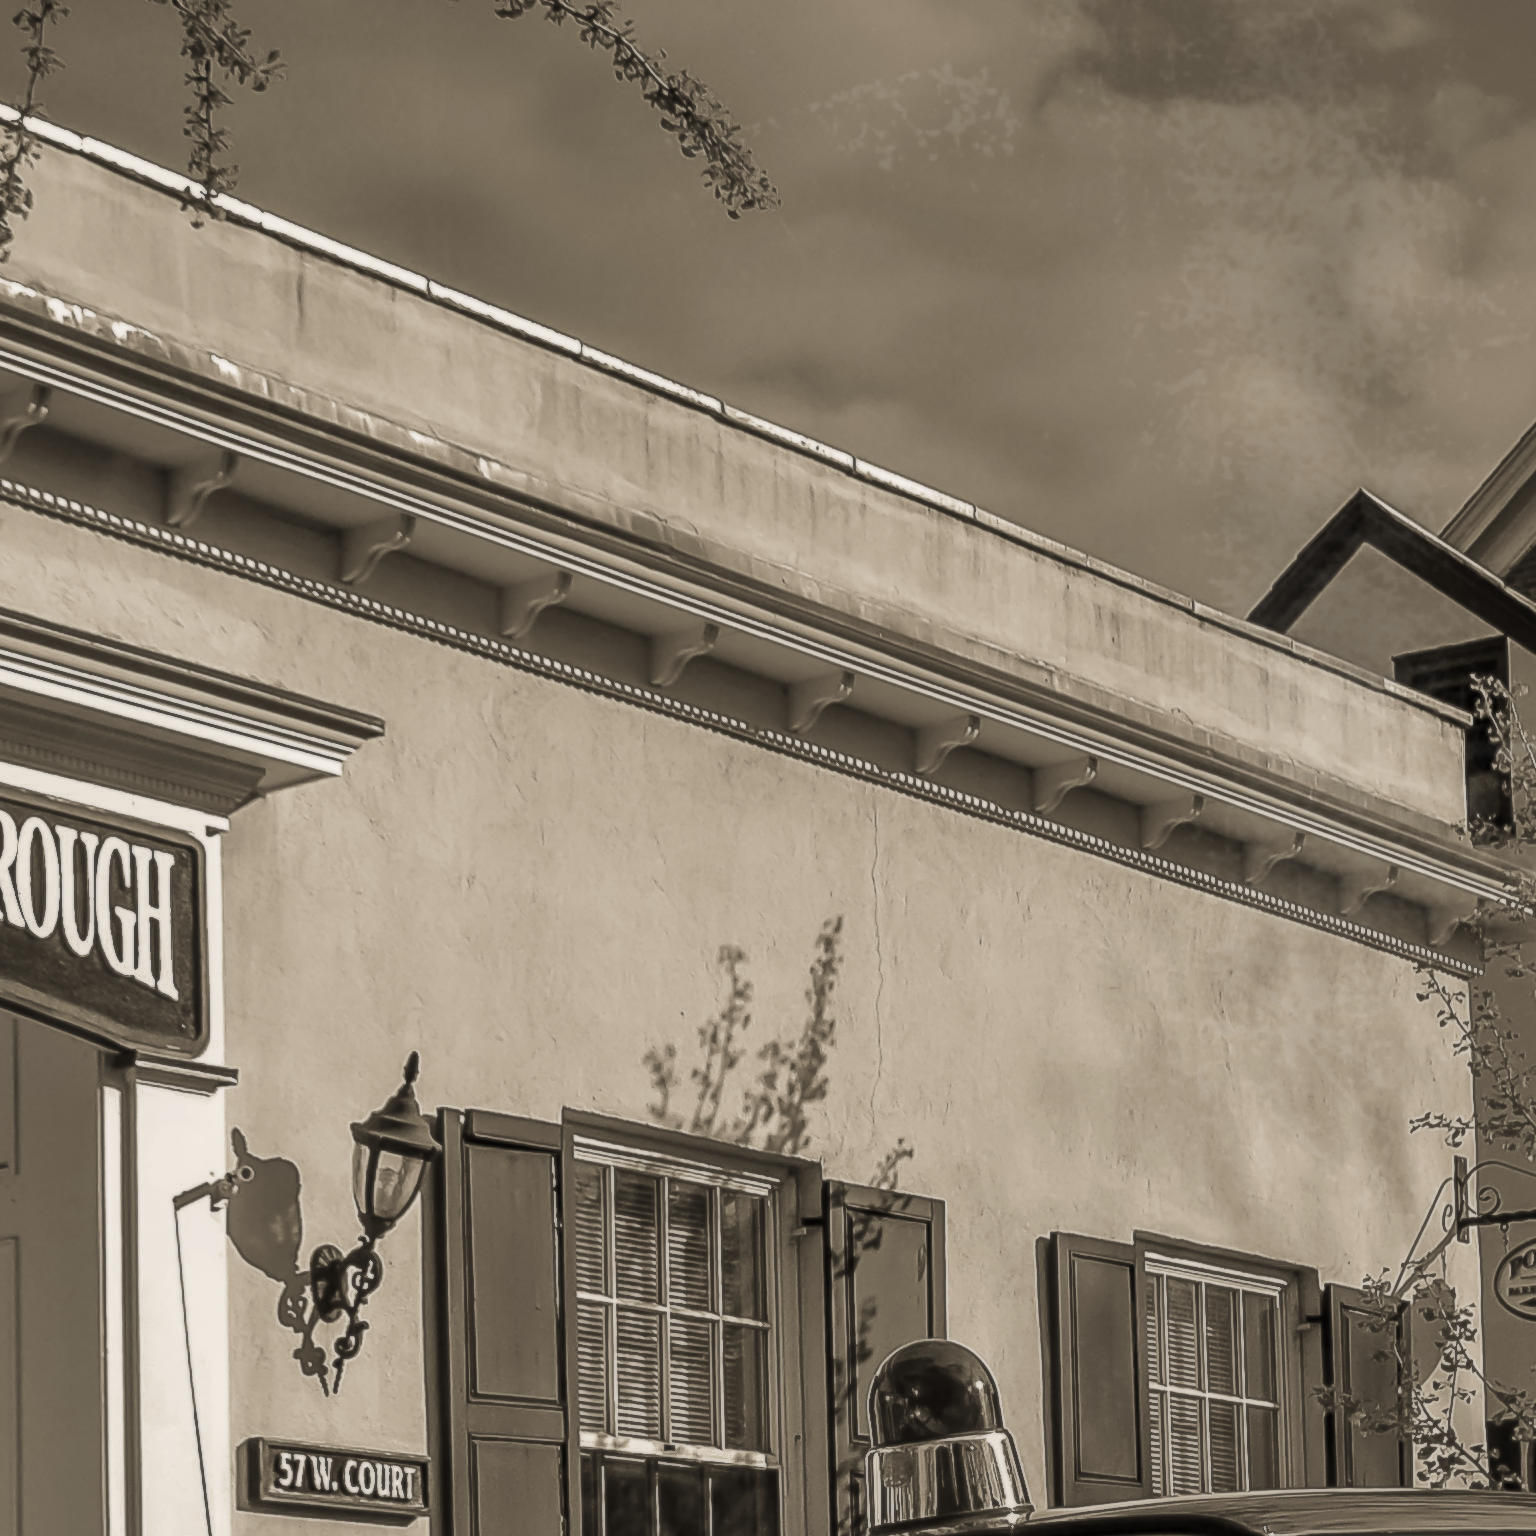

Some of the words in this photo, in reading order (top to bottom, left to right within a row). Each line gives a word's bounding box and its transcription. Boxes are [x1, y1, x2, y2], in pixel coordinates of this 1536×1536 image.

[278, 1452, 308, 1488] 57
[311, 1456, 338, 1492] W.
[343, 1459, 417, 1500] COURT
